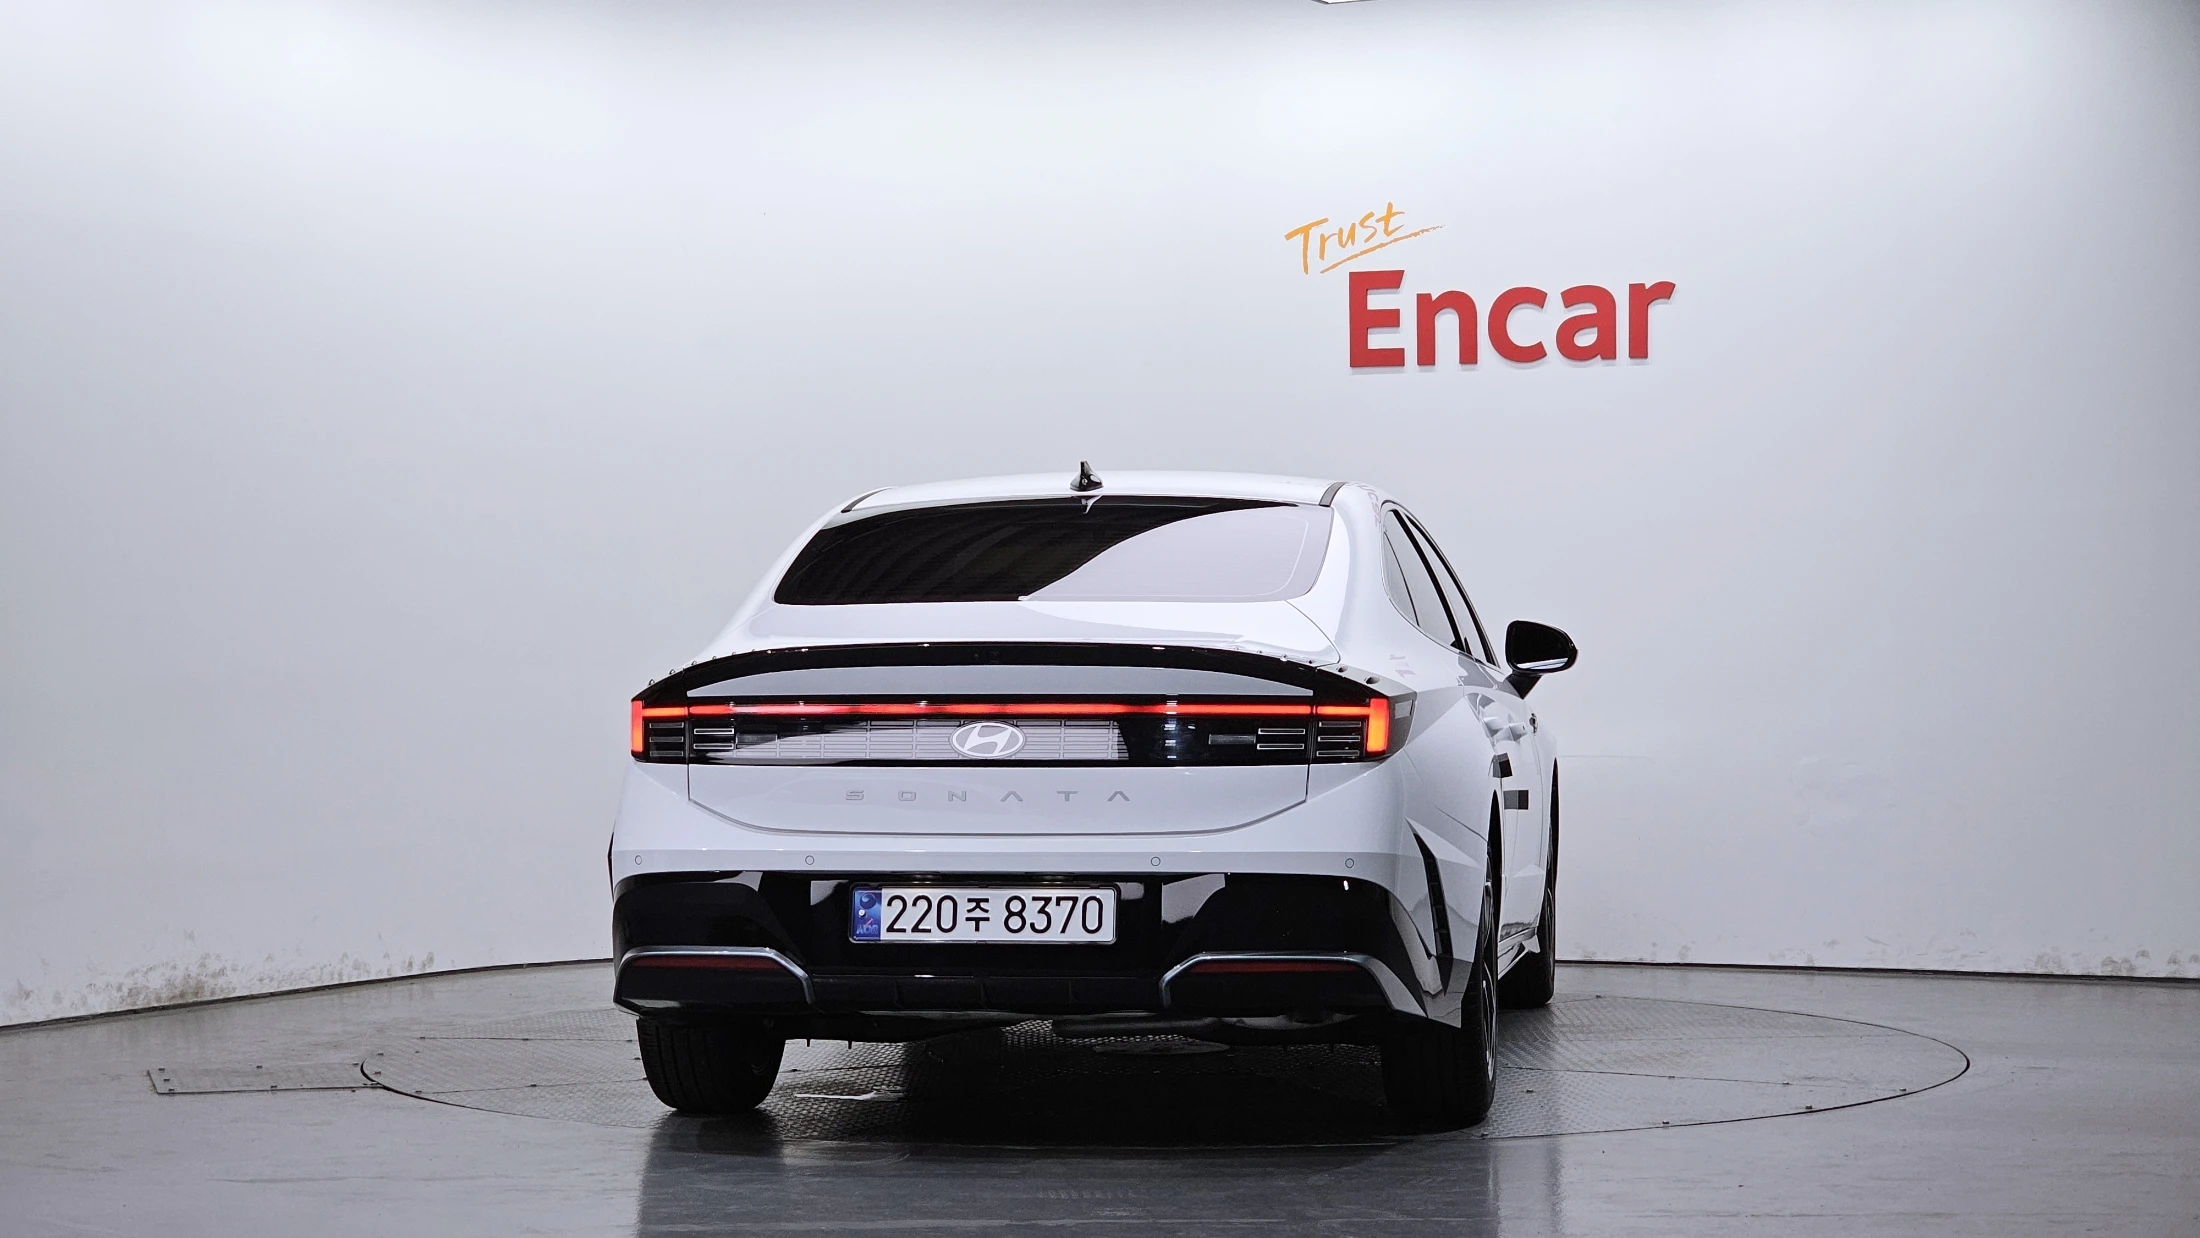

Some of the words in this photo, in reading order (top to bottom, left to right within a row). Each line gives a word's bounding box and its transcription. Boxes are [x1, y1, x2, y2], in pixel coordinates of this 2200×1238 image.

[1284, 202, 1406, 275] Trust
[1348, 269, 1677, 368] Encar
[845, 789, 1131, 802] SONATA
[885, 894, 991, 933] 220주
[1003, 895, 1104, 934] 8370
